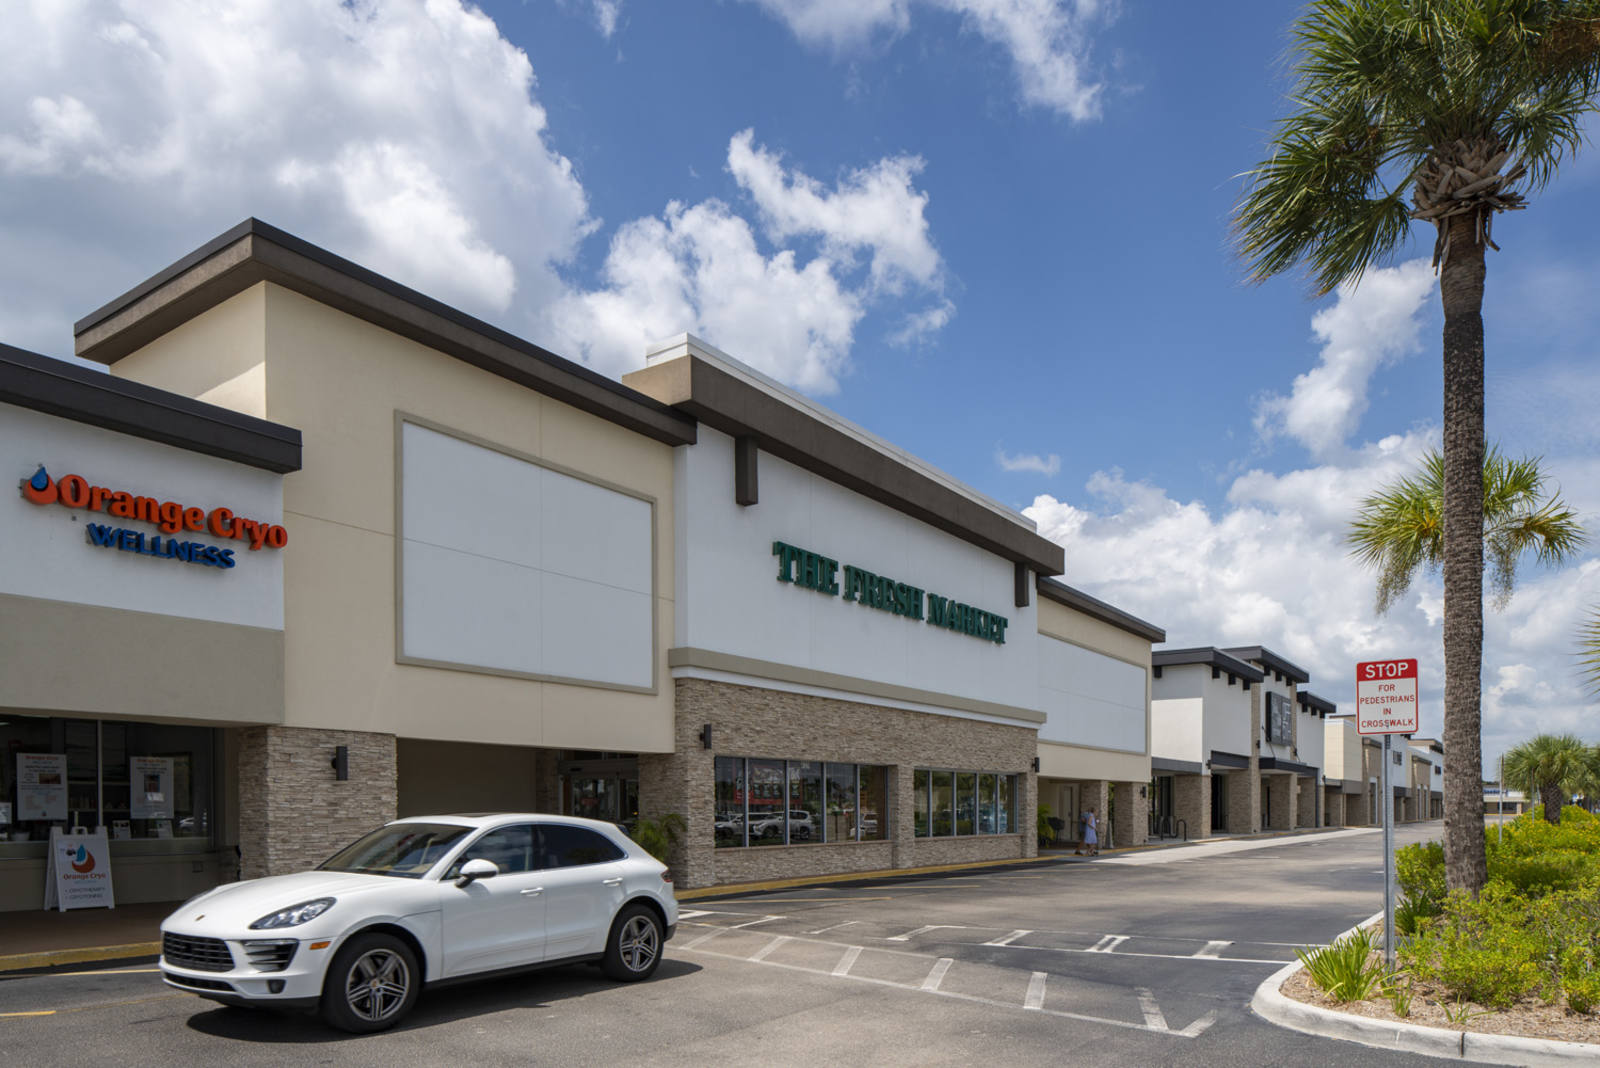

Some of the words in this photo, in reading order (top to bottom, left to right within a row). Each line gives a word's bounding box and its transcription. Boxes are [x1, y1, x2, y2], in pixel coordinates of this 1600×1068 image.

[58, 474, 205, 534] Orange
[207, 507, 288, 550] Cryo
[86, 523, 236, 569] WELLNESS
[772, 541, 839, 596] THE
[843, 565, 925, 621] FRESH
[927, 593, 1008, 645] MARKET
[1365, 662, 1409, 678] STOP
[1378, 684, 1396, 693] FOR
[1360, 695, 1415, 705] PEDESTRIANS
[1382, 707, 1392, 715] IN
[1361, 718, 1414, 729] CROSSWALK
[63, 873, 88, 881] Orange
[90, 872, 107, 880] Cryo
